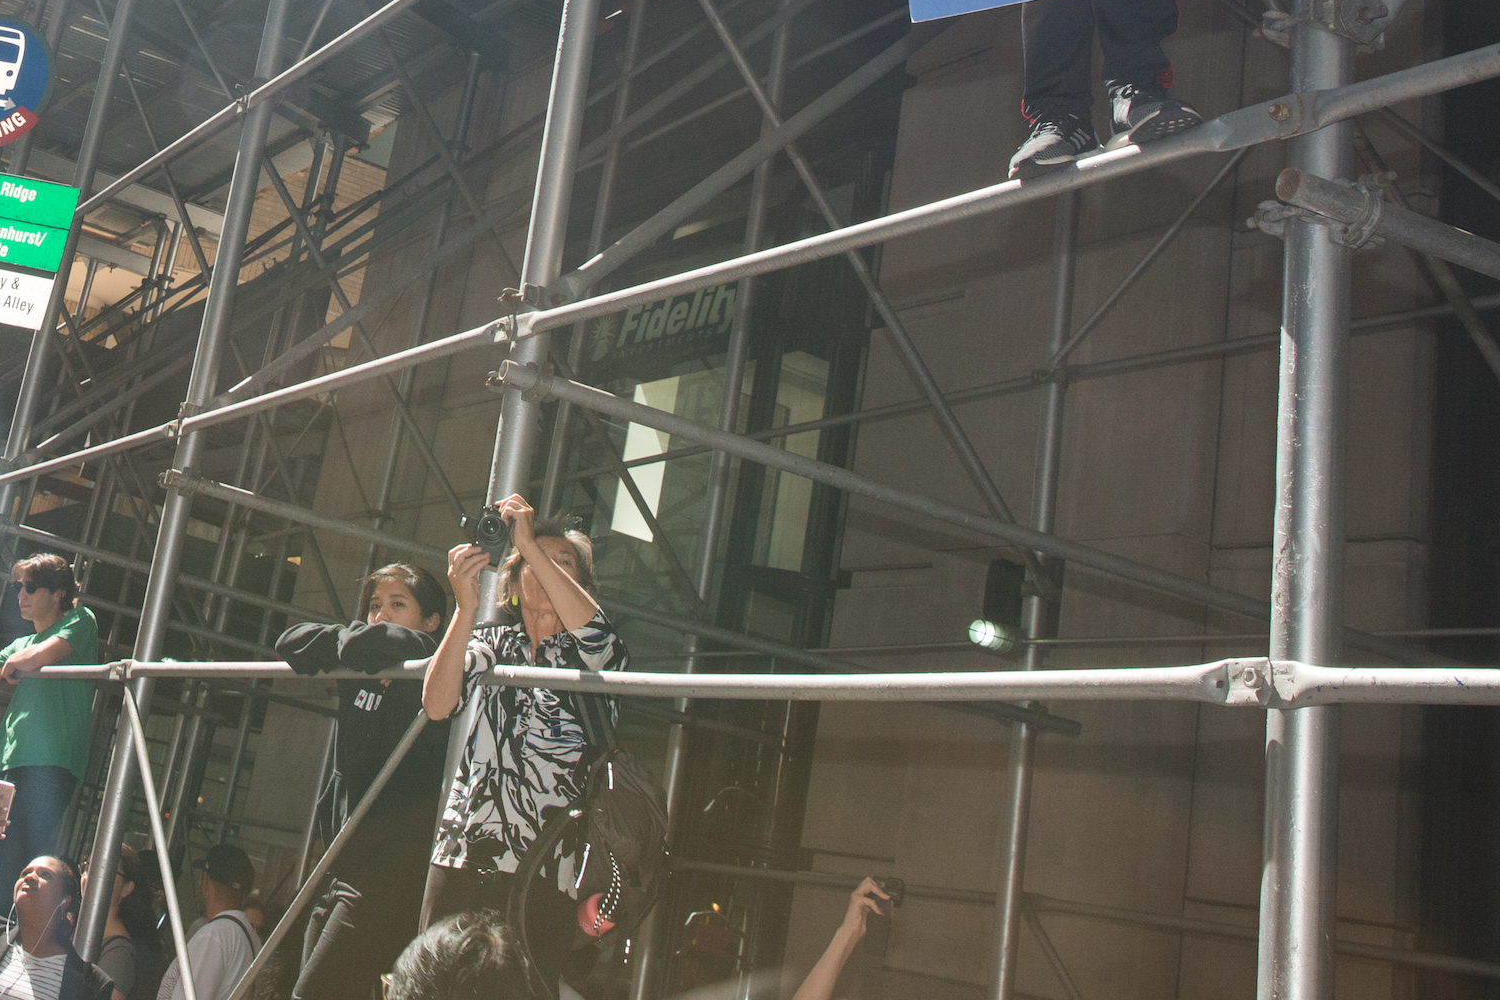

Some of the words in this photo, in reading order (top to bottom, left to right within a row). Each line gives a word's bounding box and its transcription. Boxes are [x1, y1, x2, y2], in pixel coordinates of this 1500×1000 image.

[0, 181, 37, 202] Ridge
[11, 277, 20, 290] &
[3, 295, 35, 315] Alley
[616, 283, 738, 348] Fidelity
